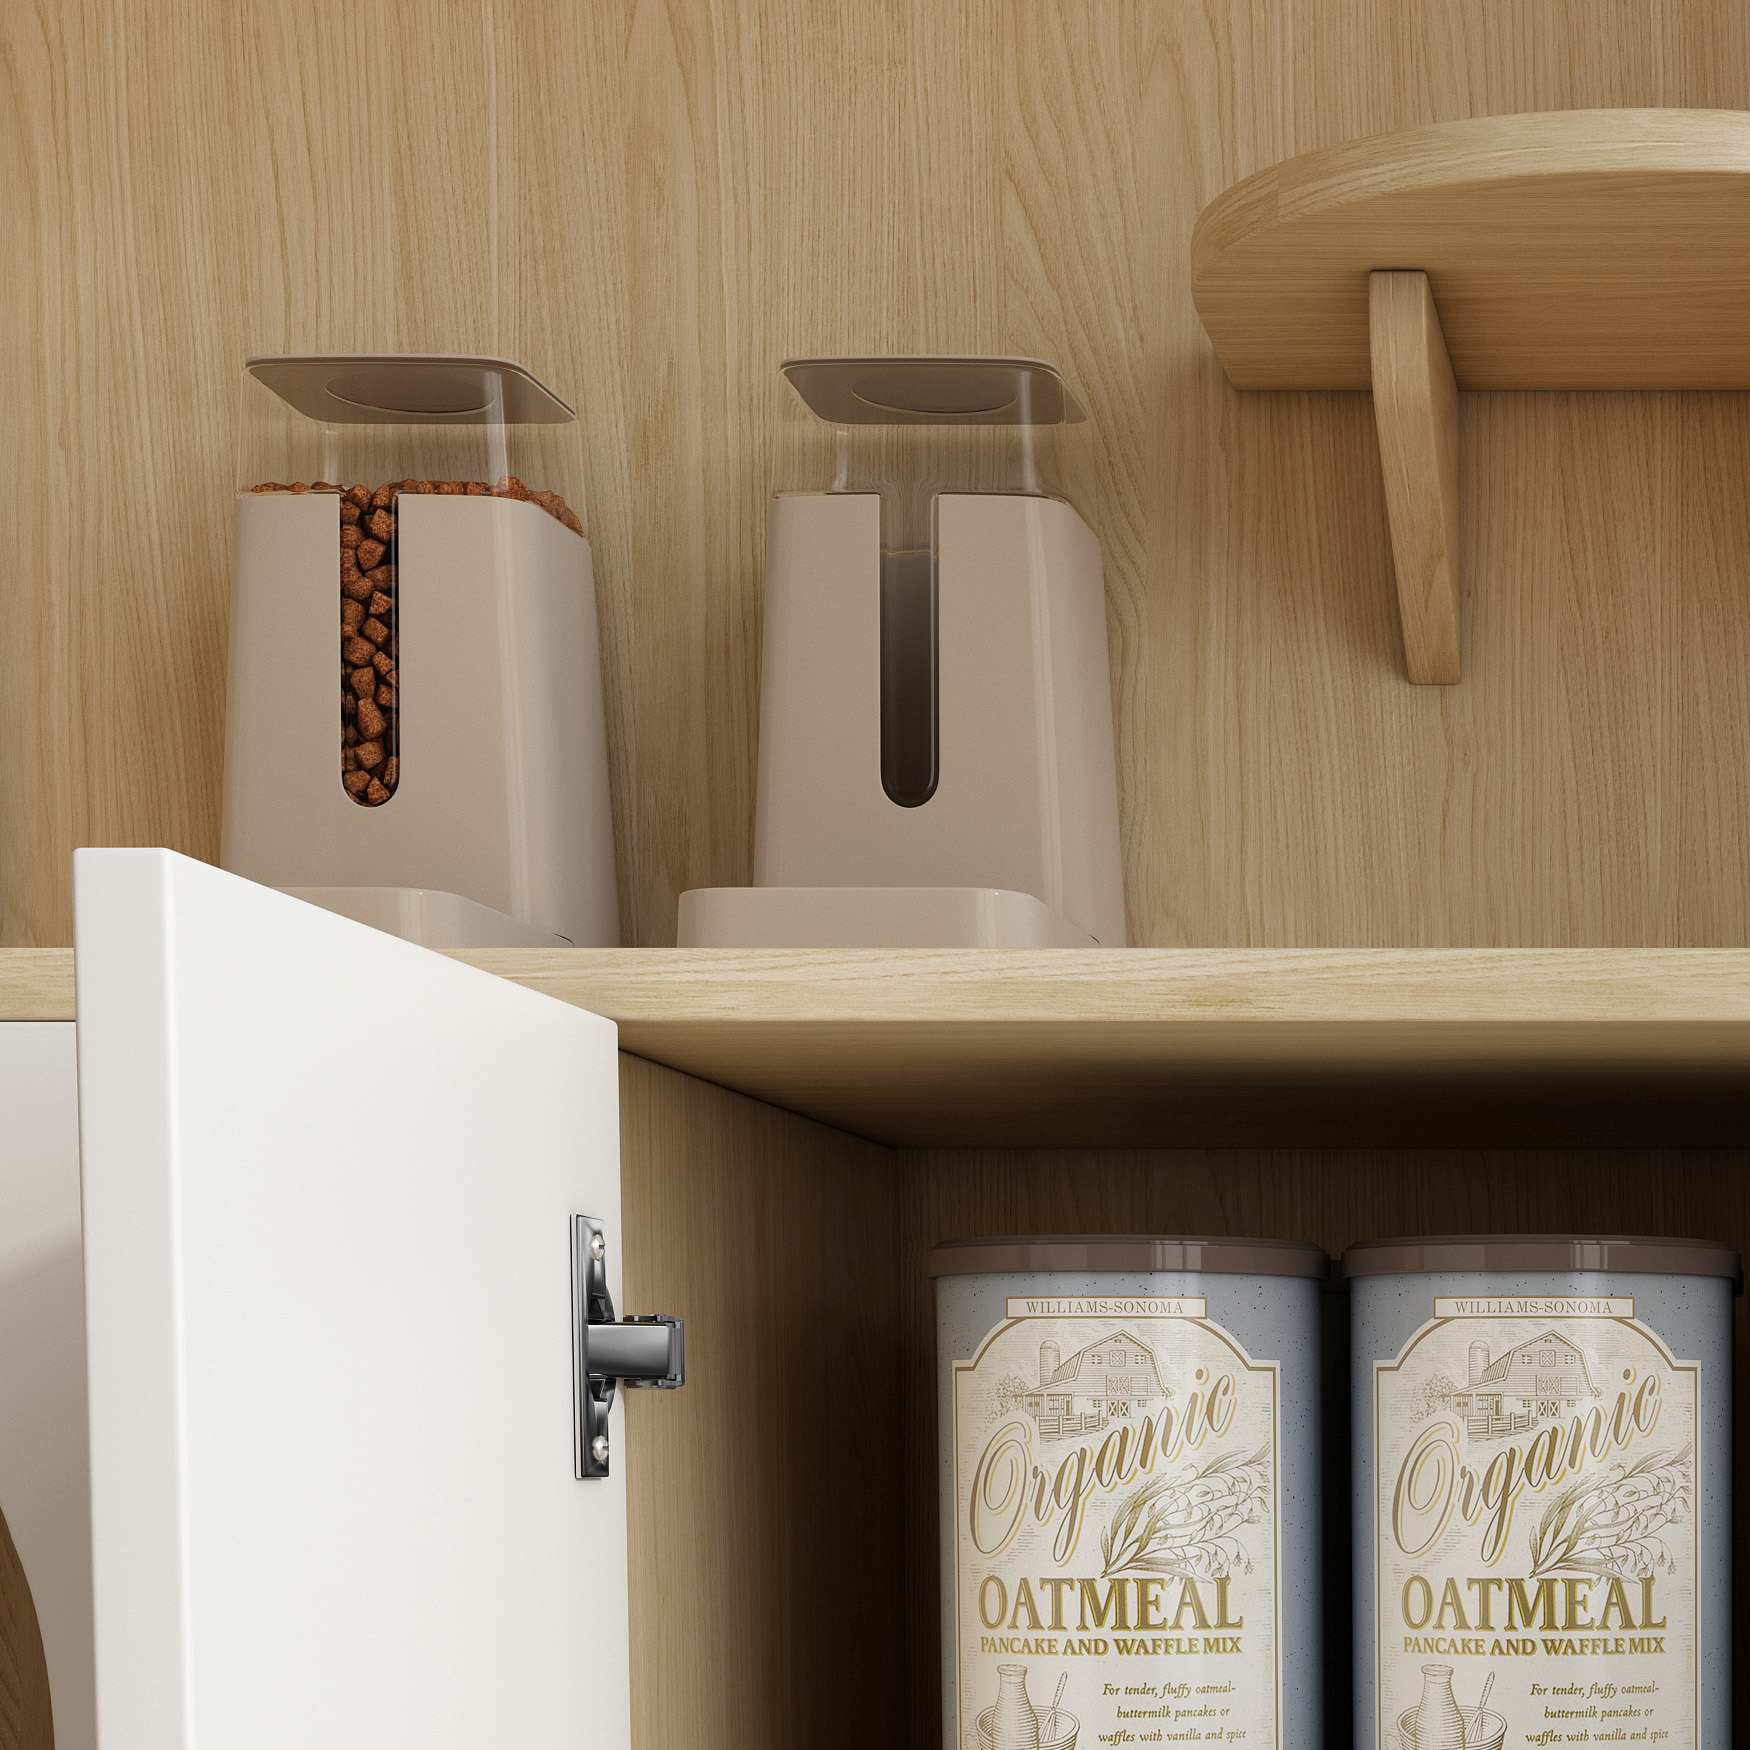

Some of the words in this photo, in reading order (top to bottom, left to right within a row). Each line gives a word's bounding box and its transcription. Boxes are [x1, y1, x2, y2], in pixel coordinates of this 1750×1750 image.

[1026, 1301, 1184, 1314] WILLIAMS-SONOMA
[1455, 1301, 1613, 1314] WILLIAMS-SONOMA
[969, 1367, 1237, 1566] Organic
[1391, 1367, 1662, 1566] Organic
[978, 1574, 1244, 1632] OATMEAL
[1401, 1574, 1667, 1632] OATMEAL
[980, 1636, 1057, 1656] PANCAKE
[1063, 1638, 1109, 1656] AND
[1113, 1637, 1199, 1656] WAFFLE
[1203, 1636, 1242, 1655] MIX
[1402, 1636, 1485, 1656] PANCAKE
[1490, 1638, 1537, 1656] AND
[1541, 1637, 1625, 1656] WAFFLE
[1628, 1636, 1665, 1655] MIX
[1102, 1683, 1120, 1696] For
[1124, 1683, 1159, 1698] tender,
[1160, 1682, 1192, 1698] fluffy
[1530, 1683, 1548, 1696] For
[1551, 1683, 1586, 1698] tender,
[1587, 1682, 1618, 1698] fluffy
[1116, 1705, 1171, 1718] buttermilk
[1174, 1707, 1216, 1722] pancakes
[1220, 1708, 1231, 1717] or
[1543, 1705, 1598, 1718] buttermilk
[1600, 1707, 1641, 1722] pancakes
[1644, 1708, 1655, 1717] or
[1098, 1730, 1135, 1746] waffles
[1140, 1730, 1163, 1743] with
[1167, 1730, 1201, 1741] vanilla
[1205, 1729, 1223, 1740] and
[1226, 1730, 1247, 1743] spice
[1525, 1730, 1562, 1746] waffles
[1567, 1730, 1590, 1743] with
[1593, 1730, 1626, 1741] vanilla
[1630, 1729, 1647, 1740] and
[1650, 1730, 1669, 1743] spice
